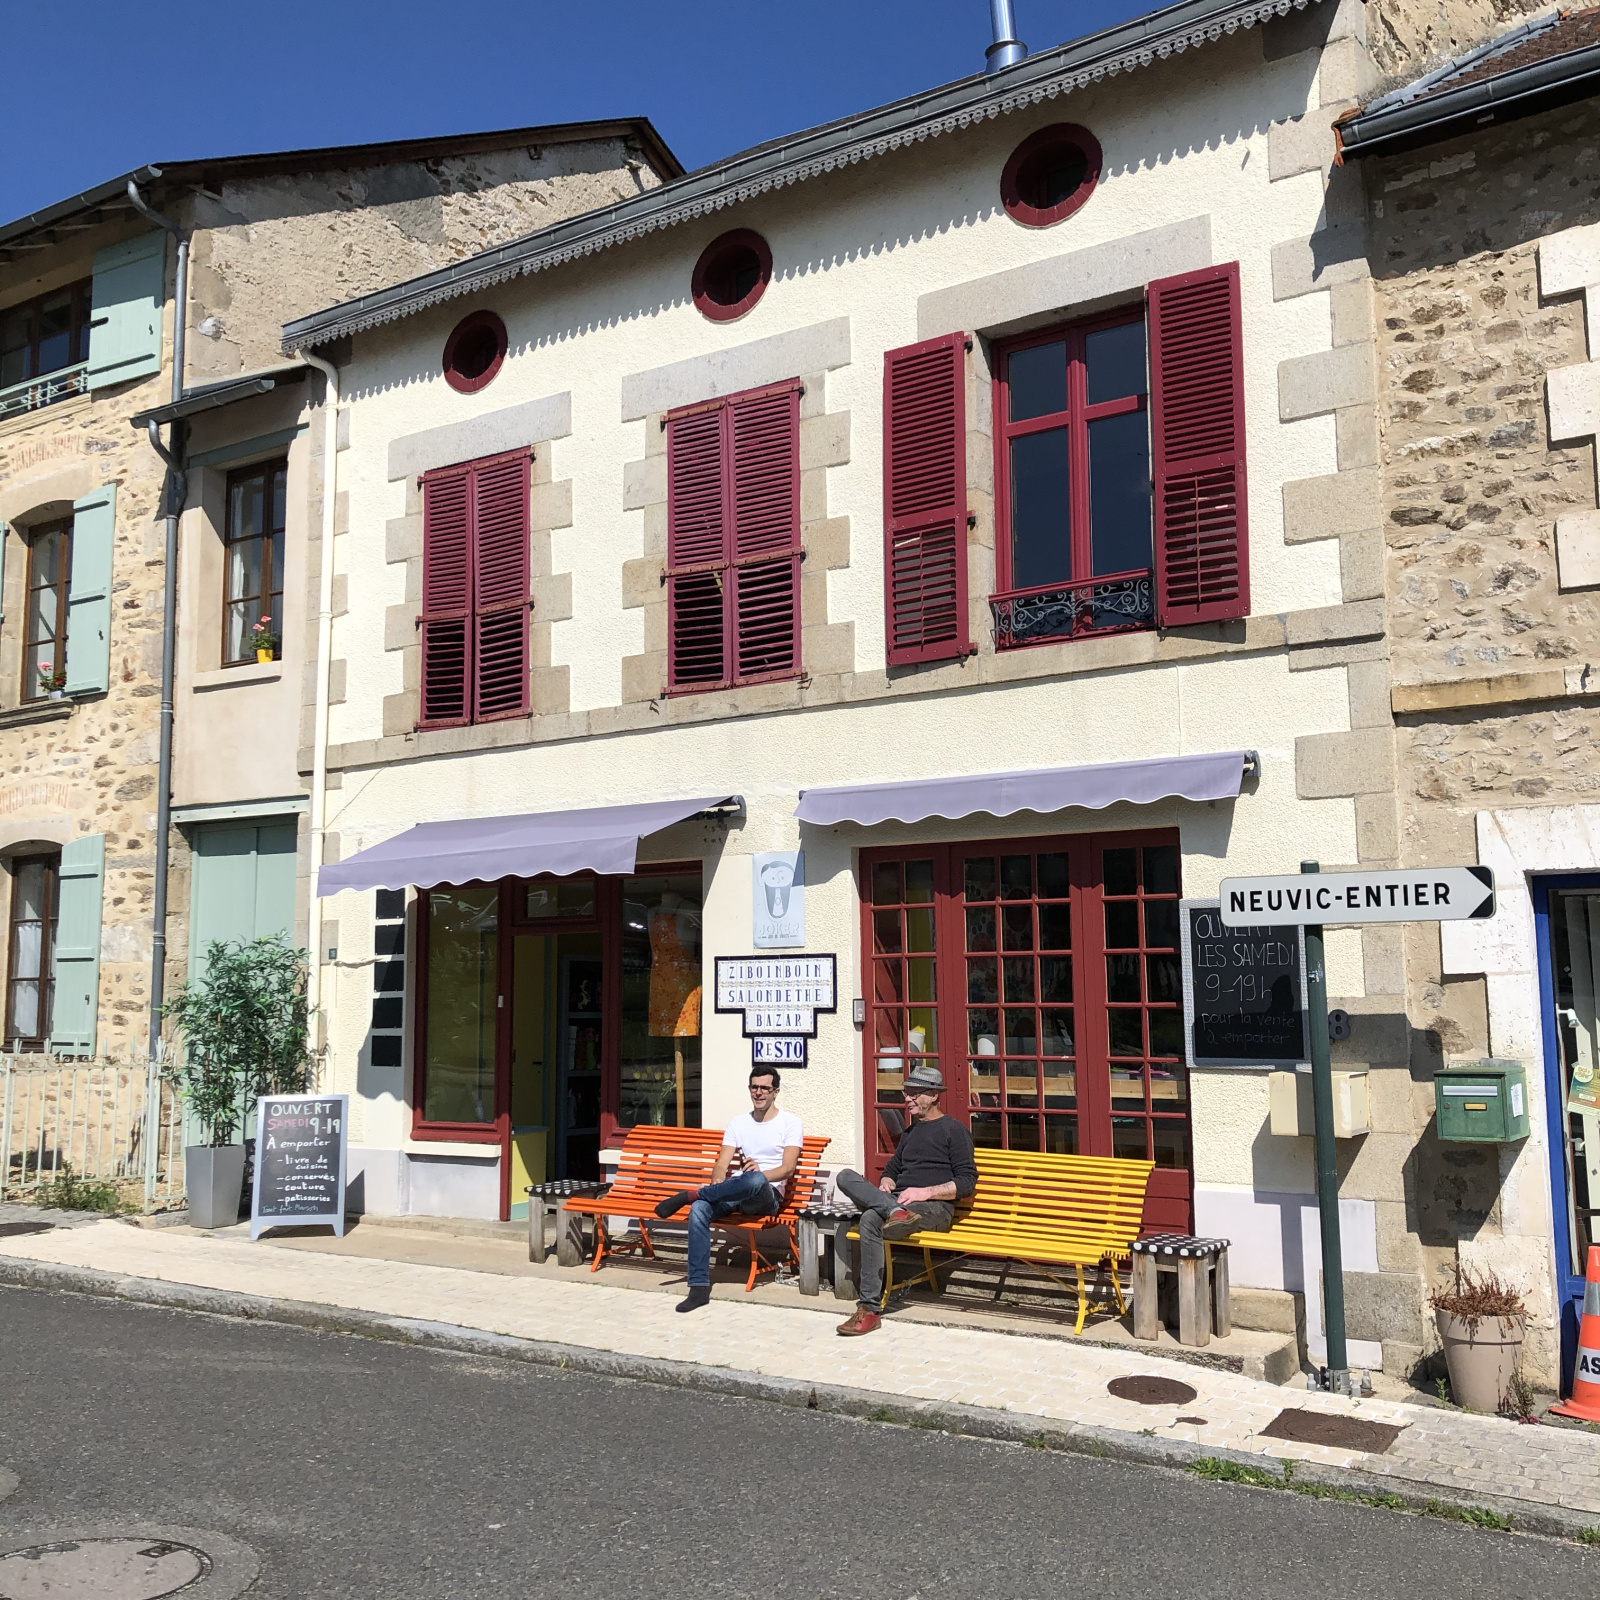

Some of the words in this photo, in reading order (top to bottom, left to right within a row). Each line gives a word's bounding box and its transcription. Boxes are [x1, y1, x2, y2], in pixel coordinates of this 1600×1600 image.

[1230, 882, 1451, 913] NEUVIC-ENTIER
[1198, 944, 1227, 968] LES
[1232, 942, 1294, 967] SAMEDI
[729, 964, 821, 979] ZIBOINBOIN
[756, 1013, 801, 1027] BAZAR
[1202, 1013, 1234, 1031] pour
[1240, 1006, 1252, 1024] la
[1257, 1011, 1295, 1028] vente
[1222, 1029, 1290, 1051] emporter
[755, 1041, 802, 1059] RESTO
[271, 1102, 333, 1116] OUVERT
[267, 1118, 309, 1130] SAMEDI
[266, 1133, 276, 1150] À
[280, 1137, 331, 1152] emporter
[317, 1154, 328, 1163] de
